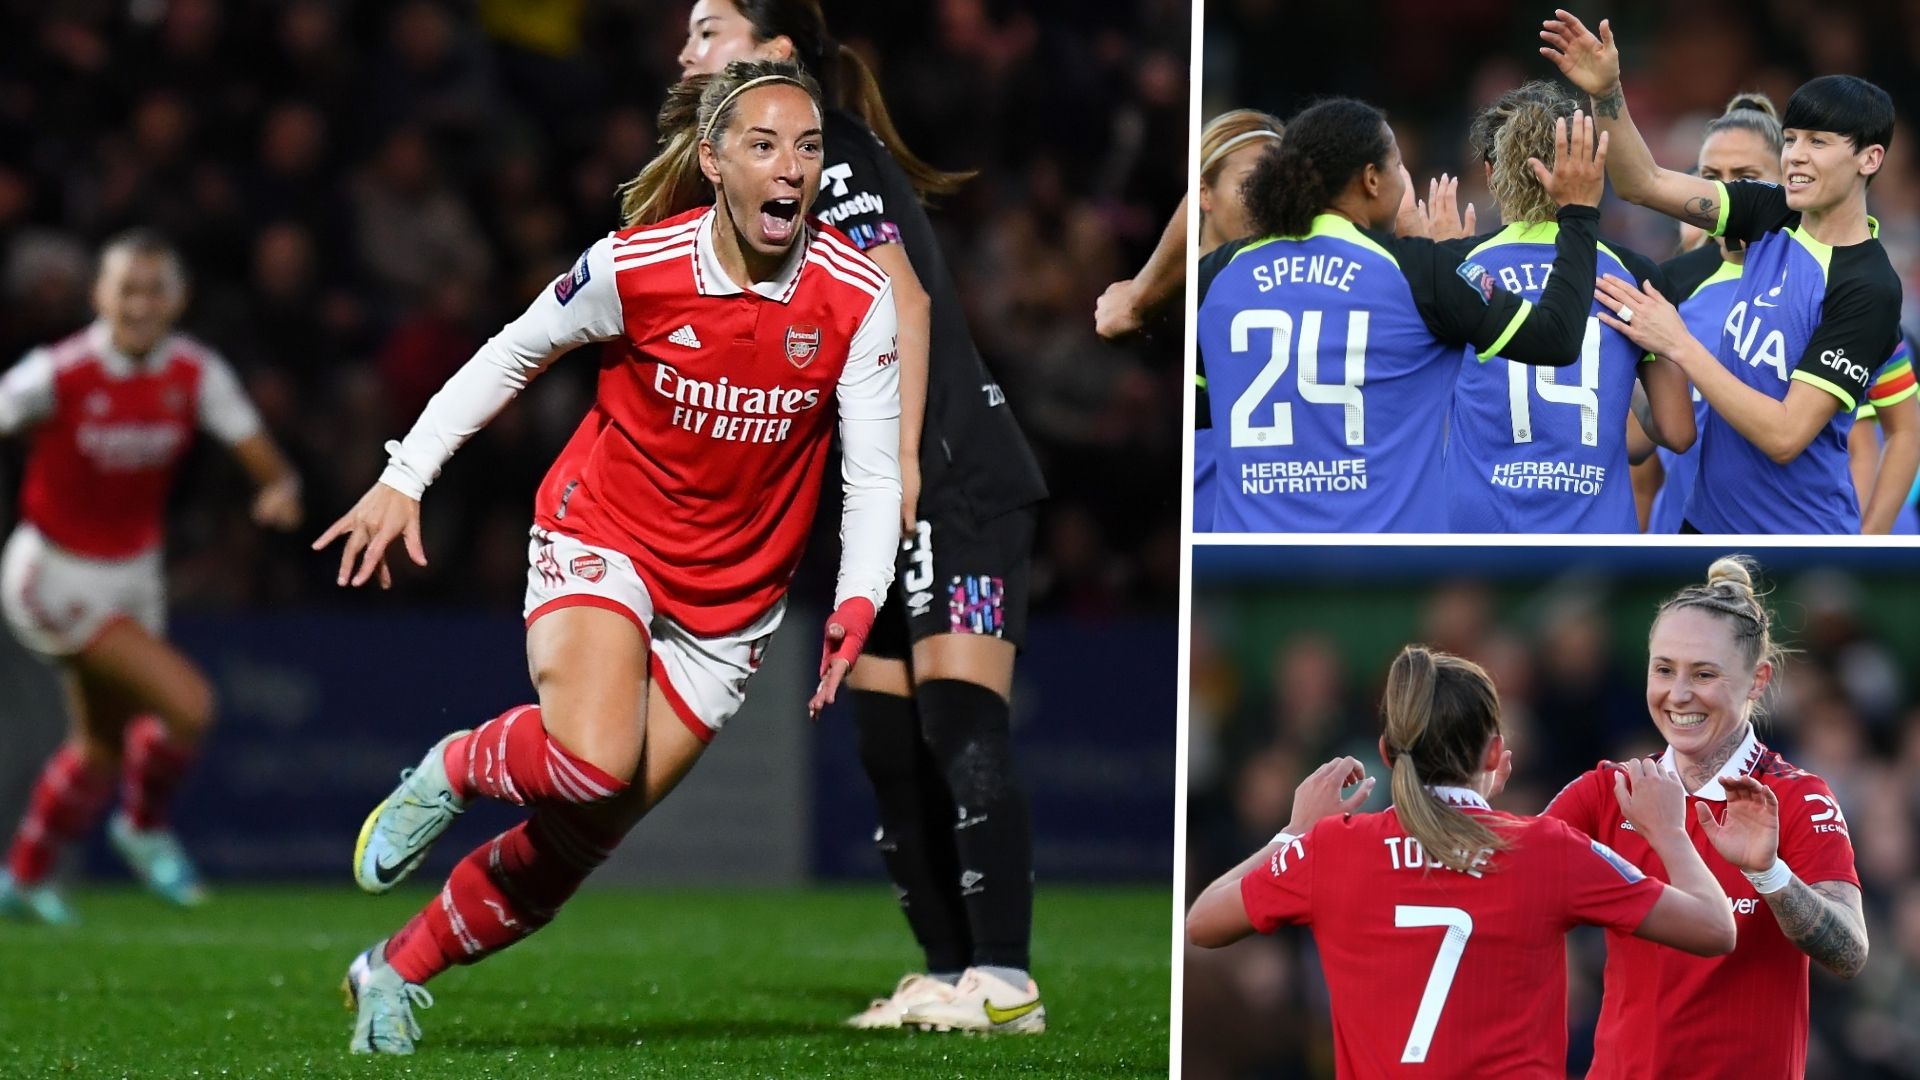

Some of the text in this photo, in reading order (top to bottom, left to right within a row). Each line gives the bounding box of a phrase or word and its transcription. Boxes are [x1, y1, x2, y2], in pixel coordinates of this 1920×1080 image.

[1253, 255, 1362, 293] SPENCE
[668, 335, 701, 349] adidas
[1724, 300, 1788, 382] AIA
[1230, 309, 1370, 448] 24
[1507, 316, 1601, 447] 14
[1820, 349, 1870, 387] cinch
[654, 362, 820, 415] Emirates
[672, 405, 792, 443] FLY BETTER
[1242, 458, 1367, 479] HERBALIFE
[1242, 475, 1368, 495] NUTRITION
[1491, 475, 1603, 496] NUTRITION
[1493, 461, 1606, 481] HERBALIFE
[1395, 904, 1474, 1064] 7
